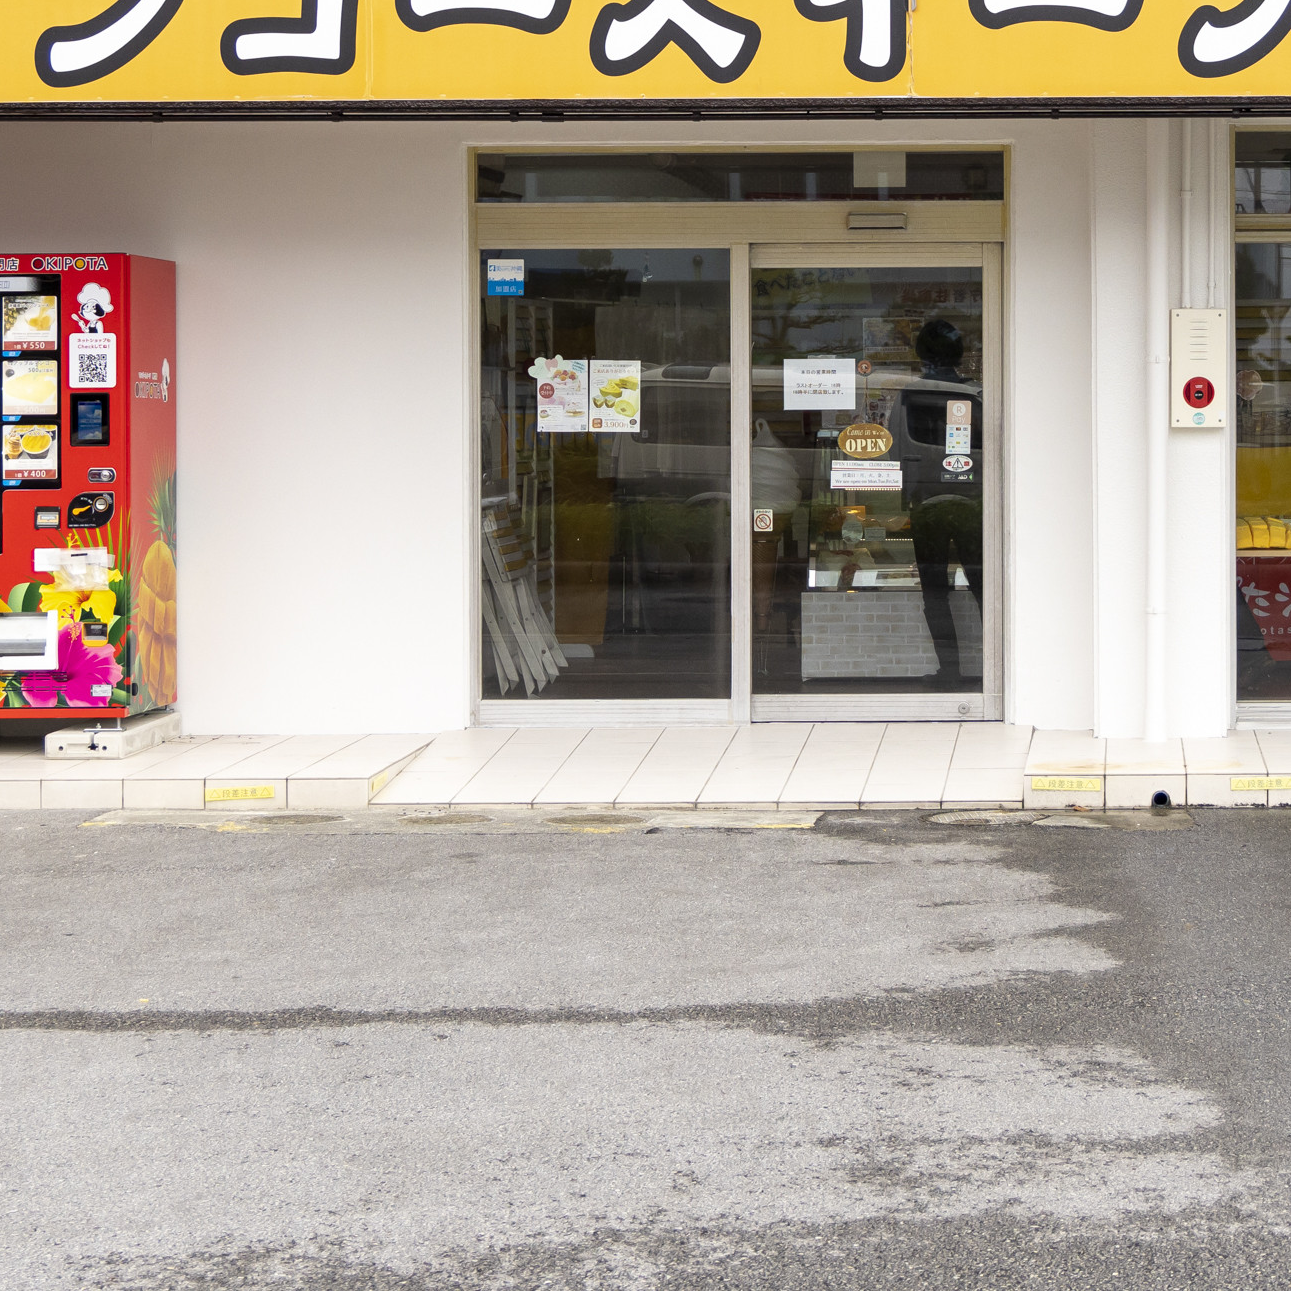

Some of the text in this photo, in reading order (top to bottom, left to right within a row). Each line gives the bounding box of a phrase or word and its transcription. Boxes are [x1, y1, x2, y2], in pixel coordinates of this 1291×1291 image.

[31, 257, 108, 271] OKIPOTA
[845, 438, 887, 452] OPEN
[1047, 778, 1085, 790] 段差注意
[1247, 778, 1284, 789] 段差注意
[222, 787, 259, 798] 段差注意
